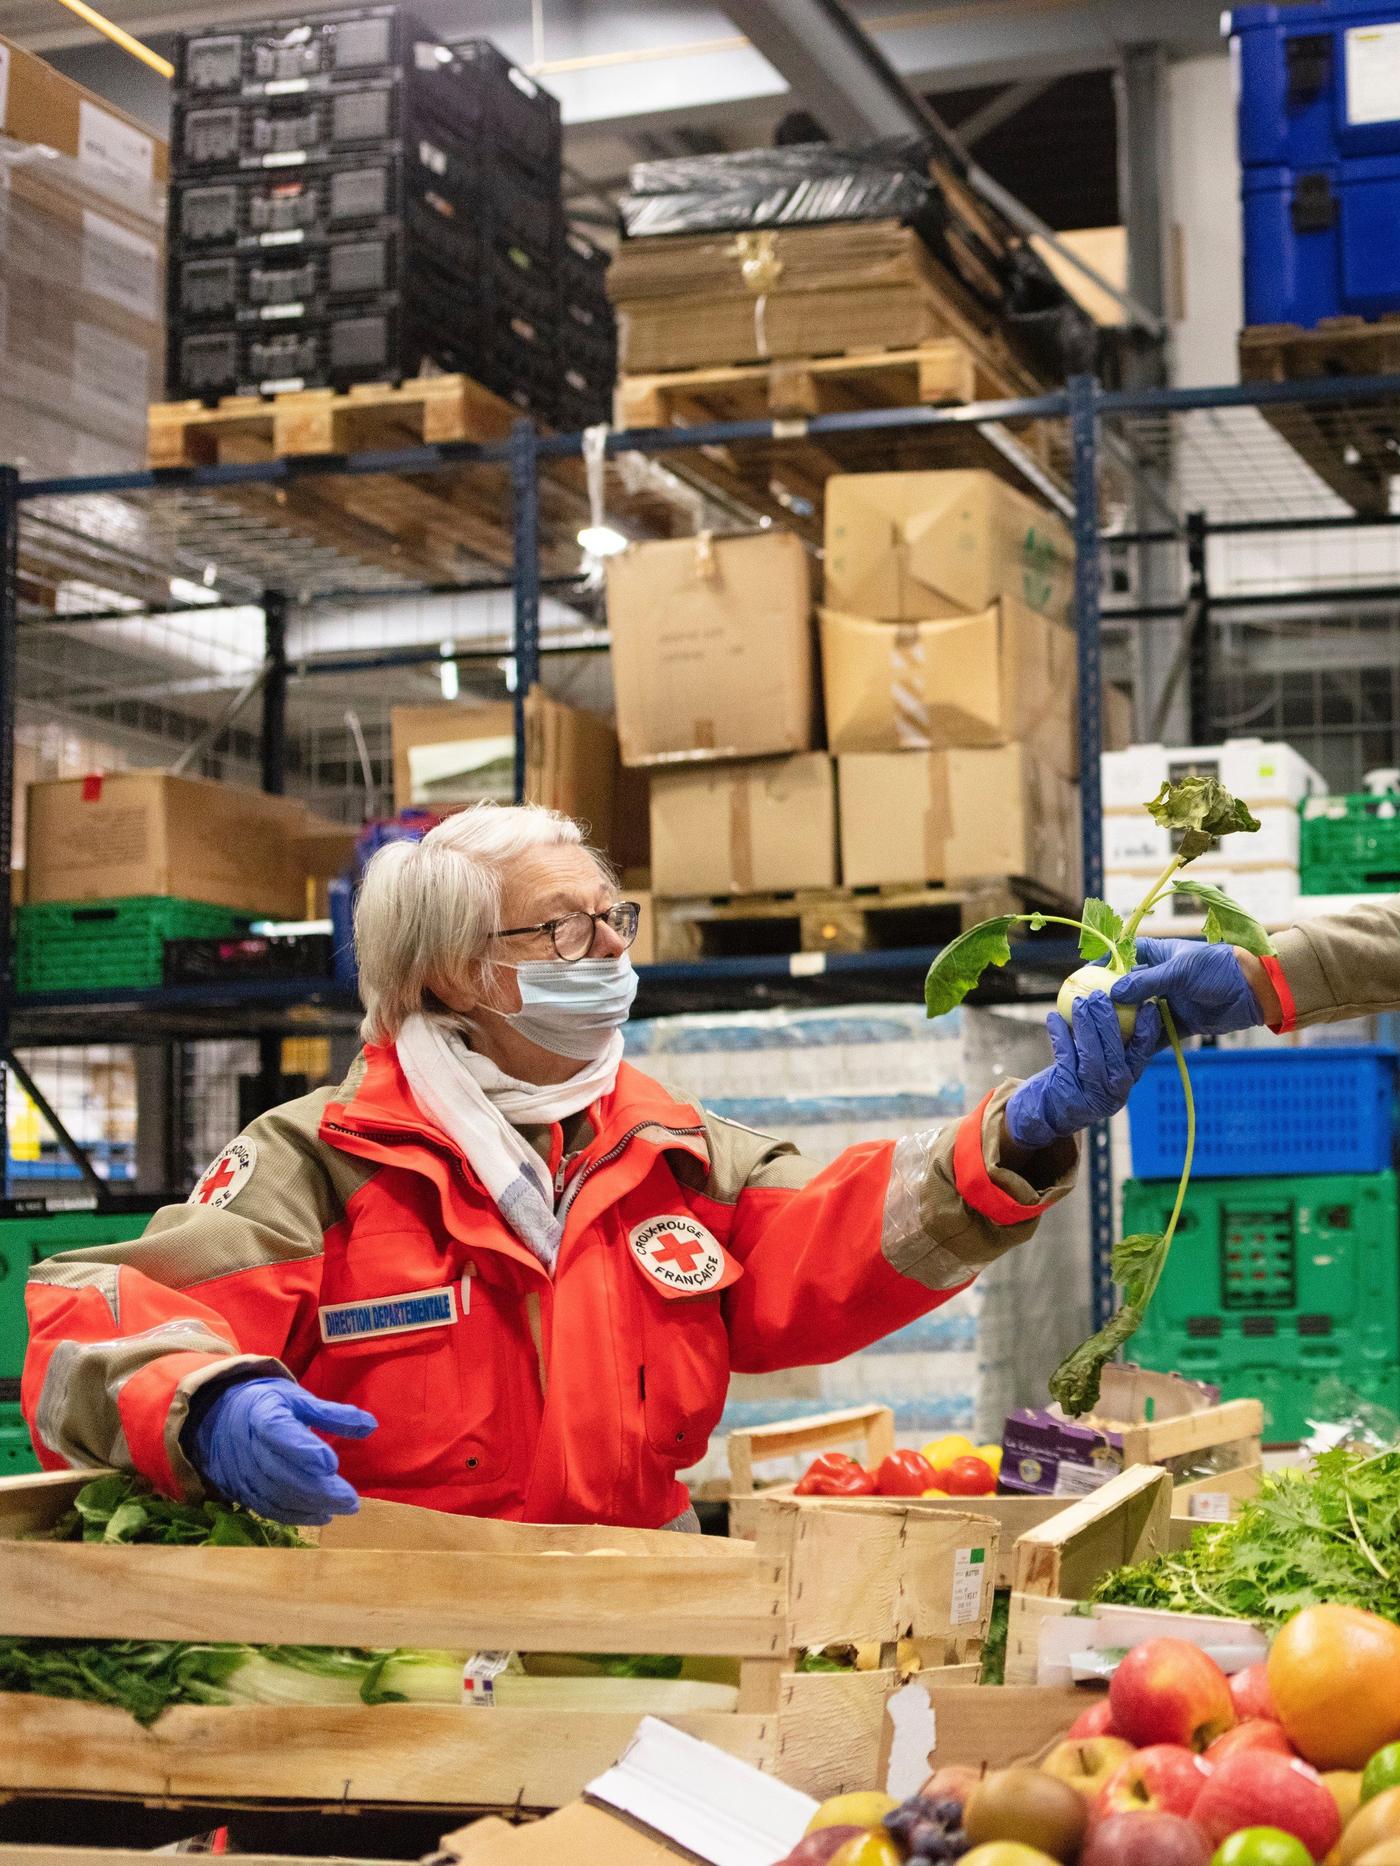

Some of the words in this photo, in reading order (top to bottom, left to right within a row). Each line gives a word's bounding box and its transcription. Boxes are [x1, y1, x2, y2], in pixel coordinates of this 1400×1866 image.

[635, 1220, 704, 1256] CROIX-ROUGE
[654, 1255, 719, 1286] FRANÇAISE
[325, 1305, 372, 1337] DIRECTION
[372, 1293, 452, 1330] DEPARTEMENTALE
